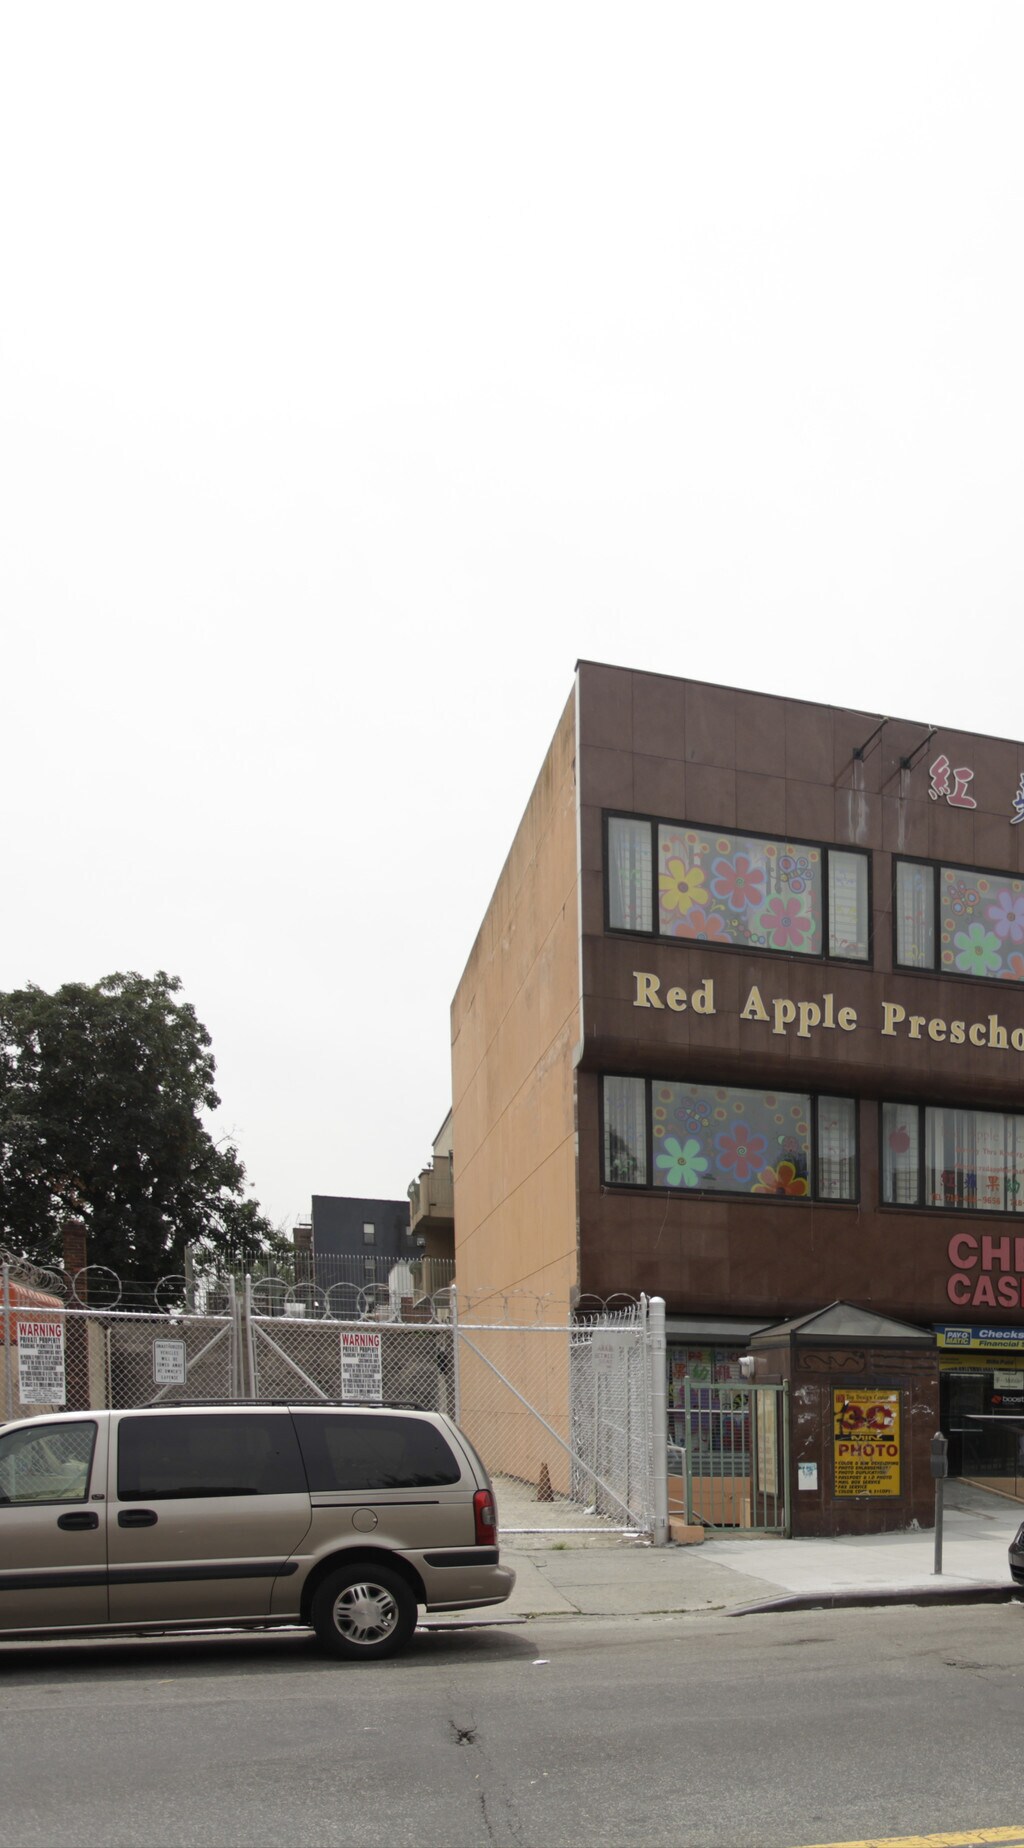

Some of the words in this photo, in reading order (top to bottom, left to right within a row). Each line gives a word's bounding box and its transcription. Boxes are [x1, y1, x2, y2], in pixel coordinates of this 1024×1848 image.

[633, 971, 716, 1015] Red
[740, 985, 858, 1038] Apple
[19, 1323, 62, 1338] WARNING
[979, 1330, 1024, 1340] Checks
[342, 1333, 380, 1347] WARNING
[979, 1340, 1020, 1348] Financial
[841, 1405, 893, 1430] 30
[838, 1444, 898, 1457] PHOTO
